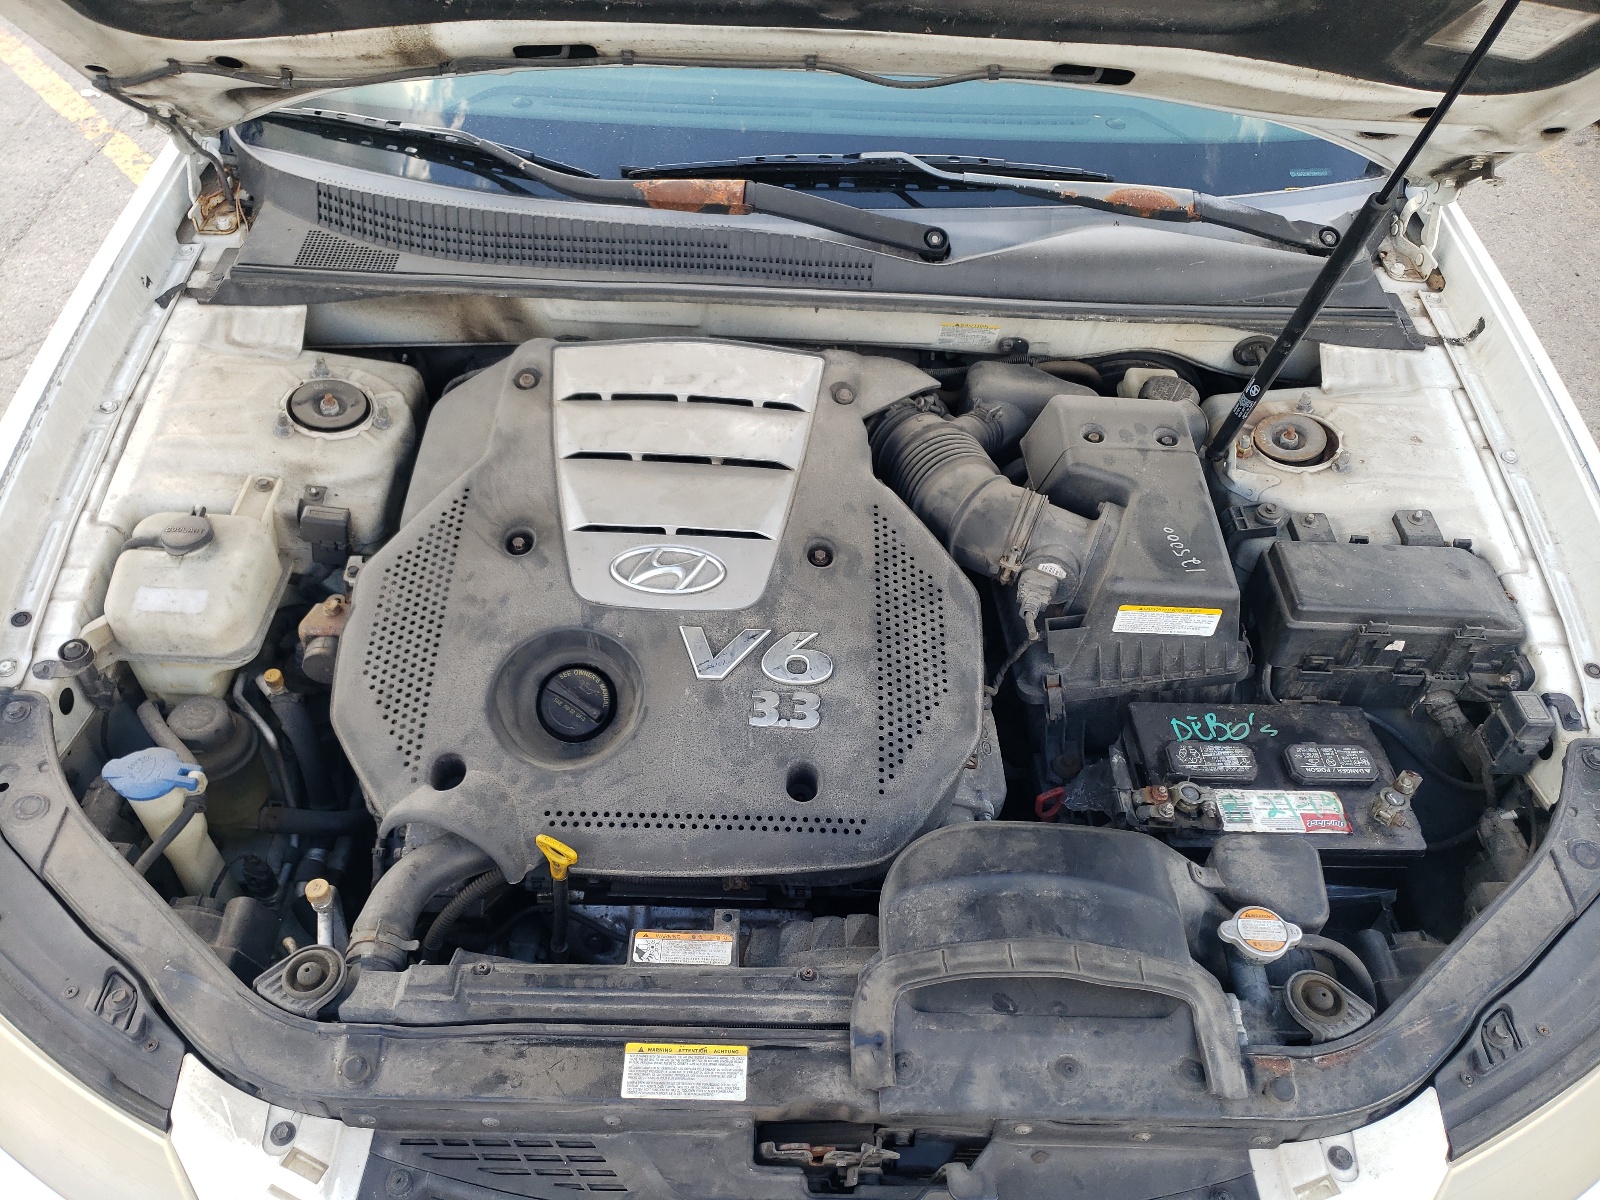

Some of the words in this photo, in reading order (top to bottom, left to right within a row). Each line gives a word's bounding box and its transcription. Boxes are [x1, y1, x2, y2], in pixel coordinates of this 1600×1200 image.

[679, 625, 834, 686] V6
[559, 670, 572, 680] SEE
[573, 669, 600, 683] OWNER'S
[600, 683, 610, 708] MANUAL
[749, 690, 821, 730] 3.3
[1306, 819, 1345, 828] Duralast
